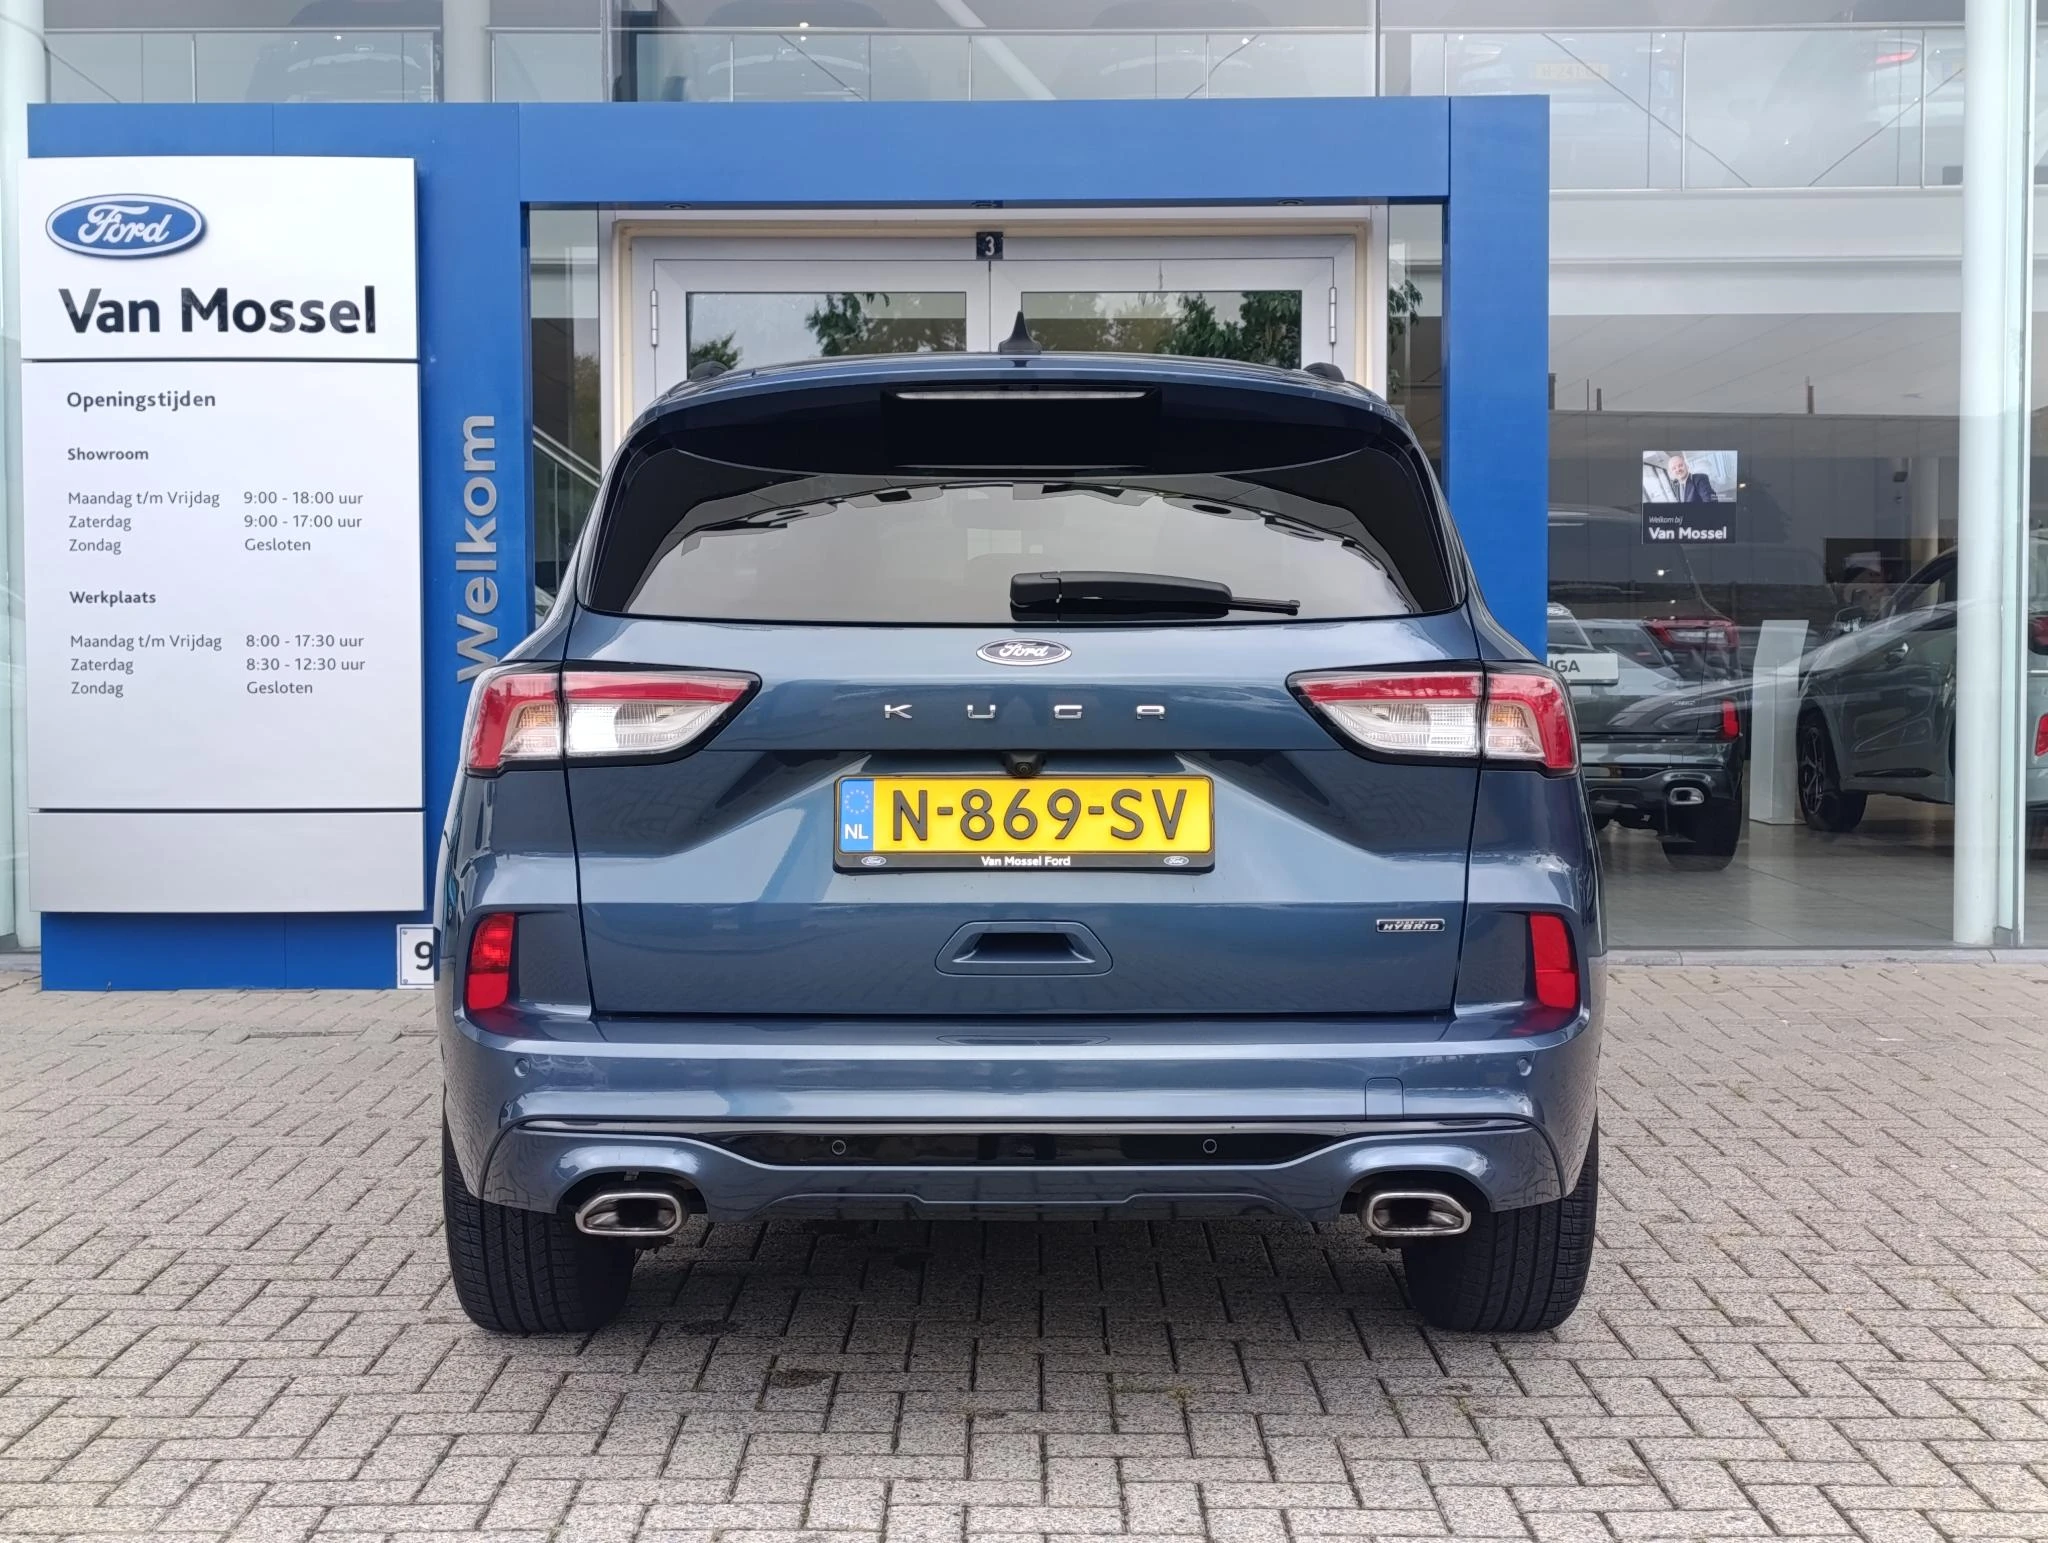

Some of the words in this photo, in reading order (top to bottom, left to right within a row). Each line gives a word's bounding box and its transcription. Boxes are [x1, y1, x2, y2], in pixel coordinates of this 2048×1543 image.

[78, 204, 170, 244] Ford
[985, 236, 995, 255] 3
[59, 289, 160, 333] Van
[181, 286, 375, 333] Mossel
[67, 391, 215, 412] Openingstijden
[68, 448, 148, 460] Showroom
[69, 491, 132, 508] Maandag
[136, 491, 162, 504] t/m
[168, 491, 219, 508] Vrijdag
[244, 492, 277, 504] 9:00
[293, 492, 334, 504] 18:00
[339, 495, 363, 504] uur
[69, 515, 131, 531] Zaterdag
[244, 515, 277, 527] 9:00
[293, 515, 332, 527] 17:00
[338, 519, 362, 527] uur
[1649, 527, 1675, 539] Van
[1679, 526, 1727, 539] Mossel
[70, 538, 121, 555] Zondag
[245, 538, 310, 551] Gesloten
[456, 415, 498, 683] Welkom
[69, 591, 157, 606] Werkplaats
[71, 634, 134, 651] Maandag
[138, 634, 164, 647] t/m
[170, 634, 222, 651] Vrijdag
[246, 635, 279, 647] 8:00
[295, 635, 334, 647] 17:30
[340, 638, 364, 647] uur
[999, 641, 1049, 657] Ford
[71, 658, 133, 674] Zaterdag
[247, 658, 279, 670] 8:30
[295, 658, 336, 670] 12:30
[342, 661, 365, 670] uur
[72, 681, 123, 698] Zondag
[247, 681, 312, 694] Gesloten
[885, 704, 1165, 720] KUGA
[893, 788, 1187, 840] N-869-SV
[845, 824, 868, 841] NL
[981, 855, 1002, 866] Van
[1004, 855, 1042, 866] Mossel
[1044, 855, 1071, 866] Ford
